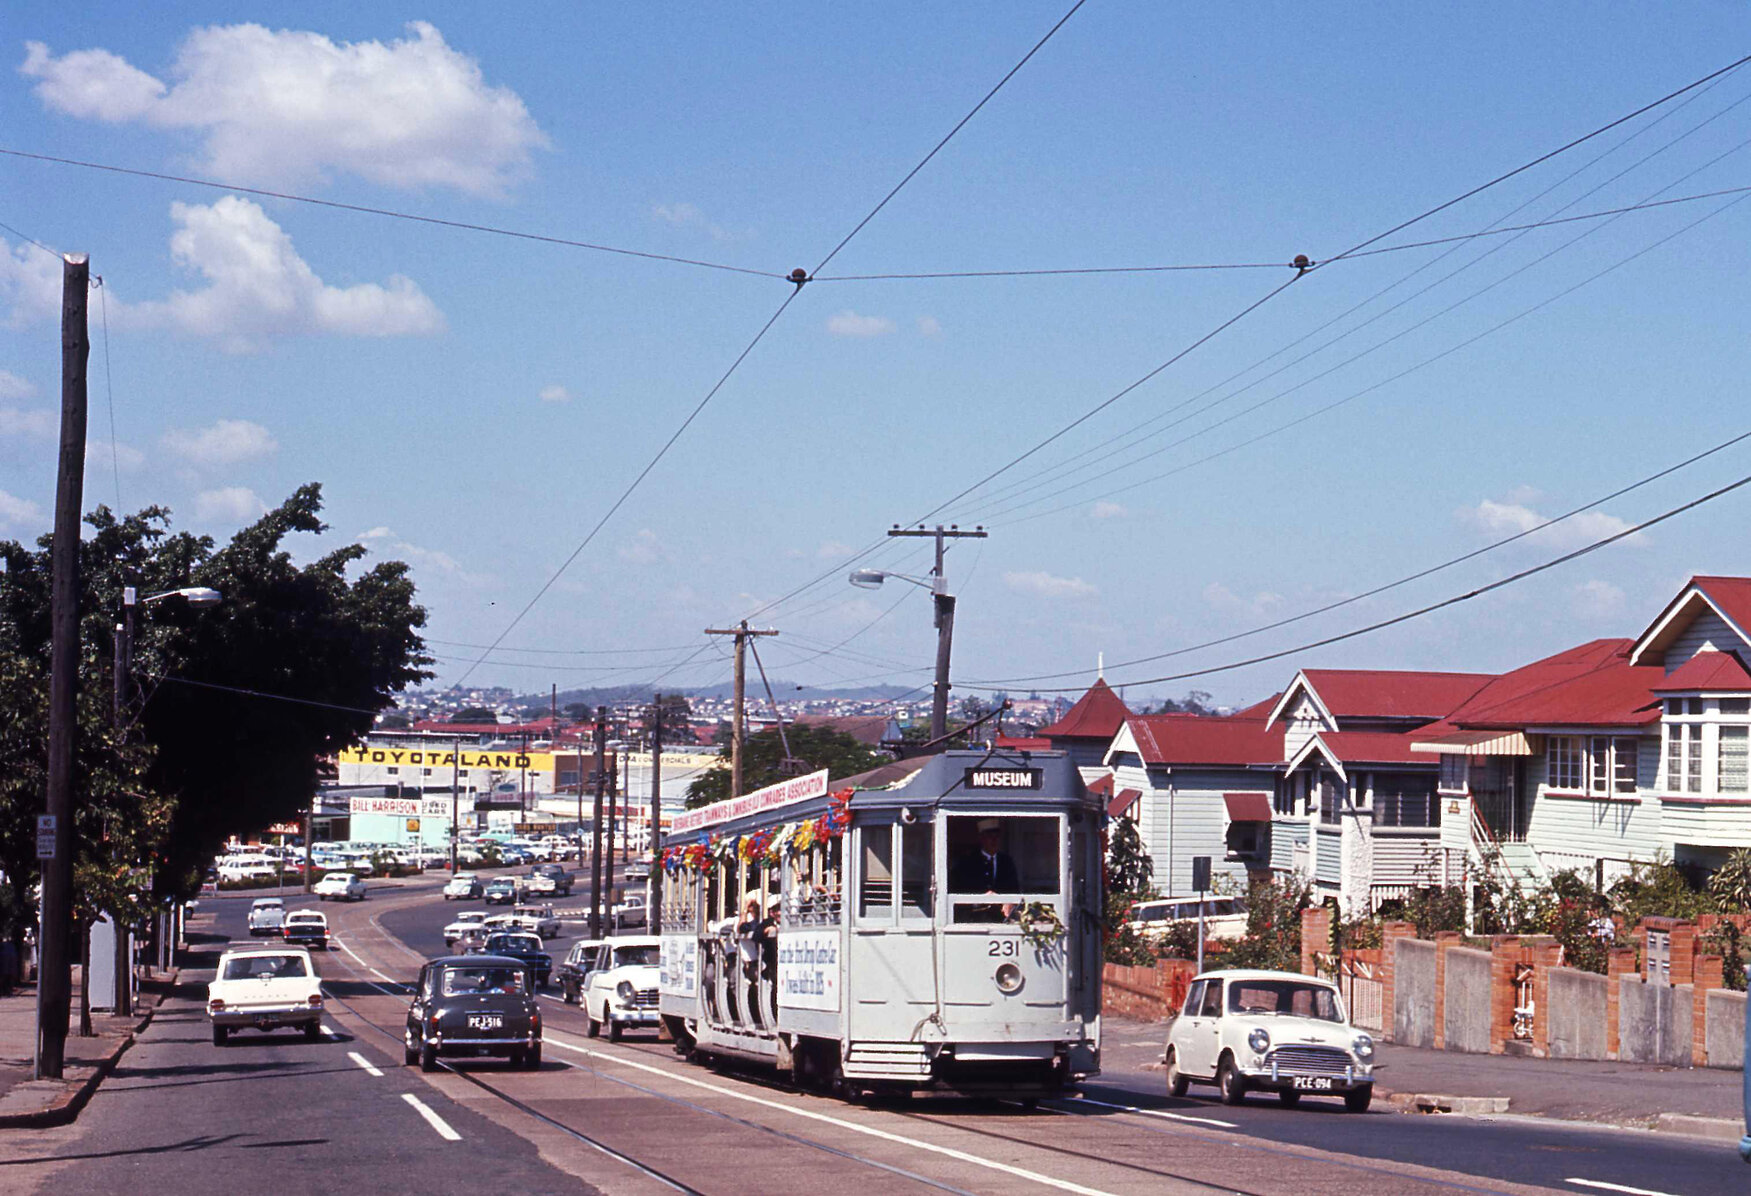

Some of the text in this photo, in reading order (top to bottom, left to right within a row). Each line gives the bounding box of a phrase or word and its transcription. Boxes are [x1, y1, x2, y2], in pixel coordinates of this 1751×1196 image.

[355, 750, 531, 768] TOYOTALAND
[972, 772, 1032, 787] MUSEUM
[352, 800, 417, 814] BILL HARRISON
[704, 803, 728, 822] TRAMWAYS
[760, 786, 786, 808] COMRADES
[787, 776, 824, 799] ASSOCIATION
[988, 941, 1020, 957] 231
